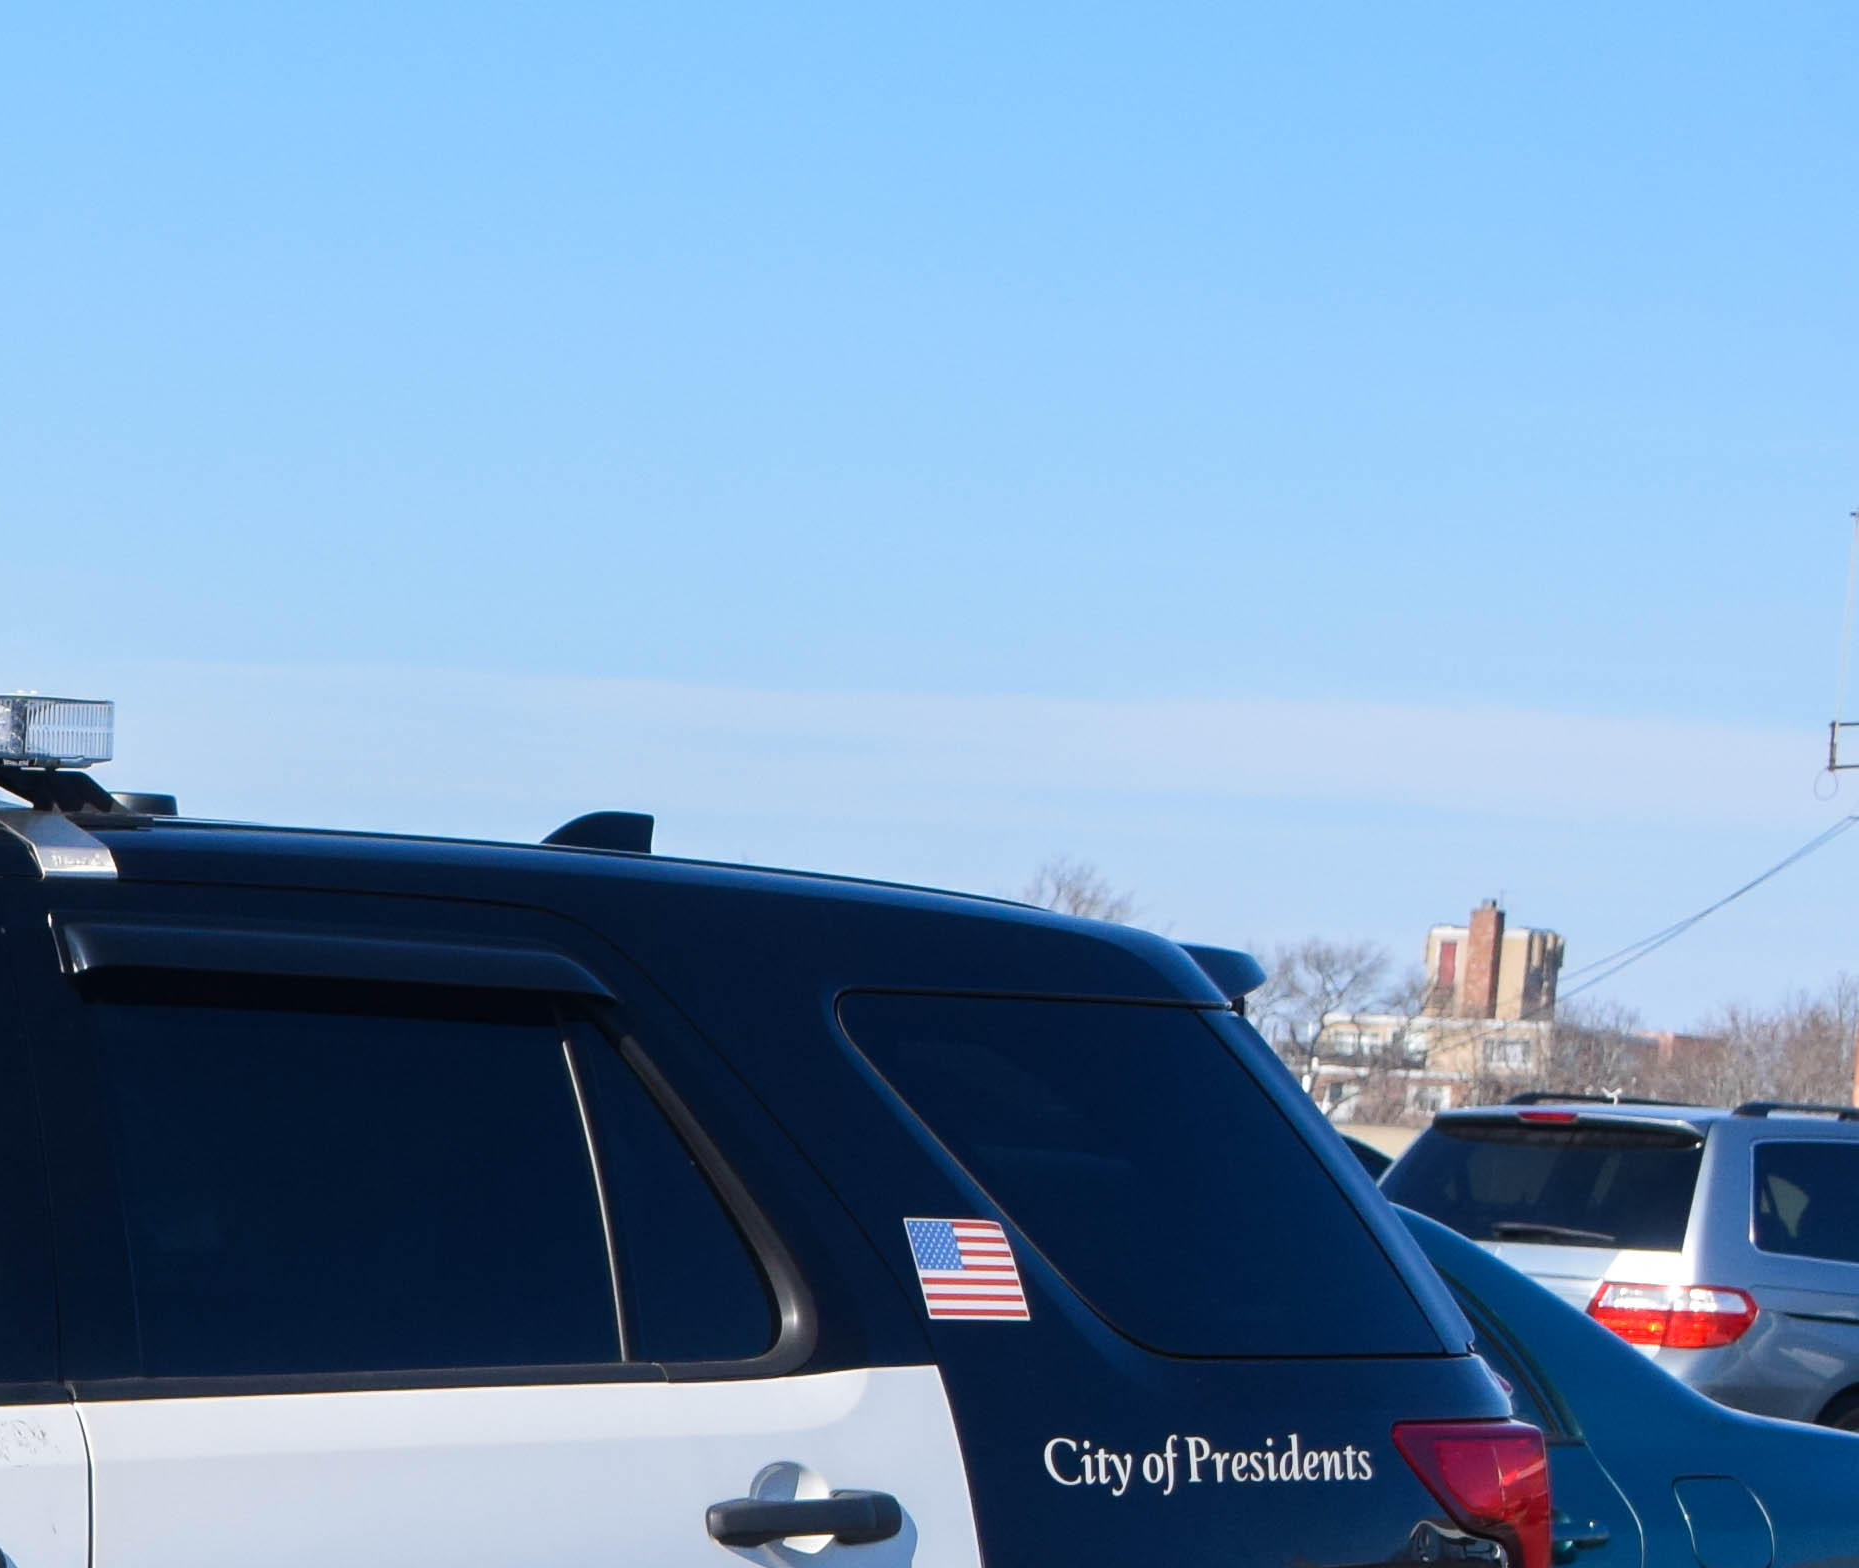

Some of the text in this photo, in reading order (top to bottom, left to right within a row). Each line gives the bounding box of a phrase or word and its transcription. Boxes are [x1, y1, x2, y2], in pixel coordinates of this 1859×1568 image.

[1043, 1434, 1373, 1496] City of Presidents
